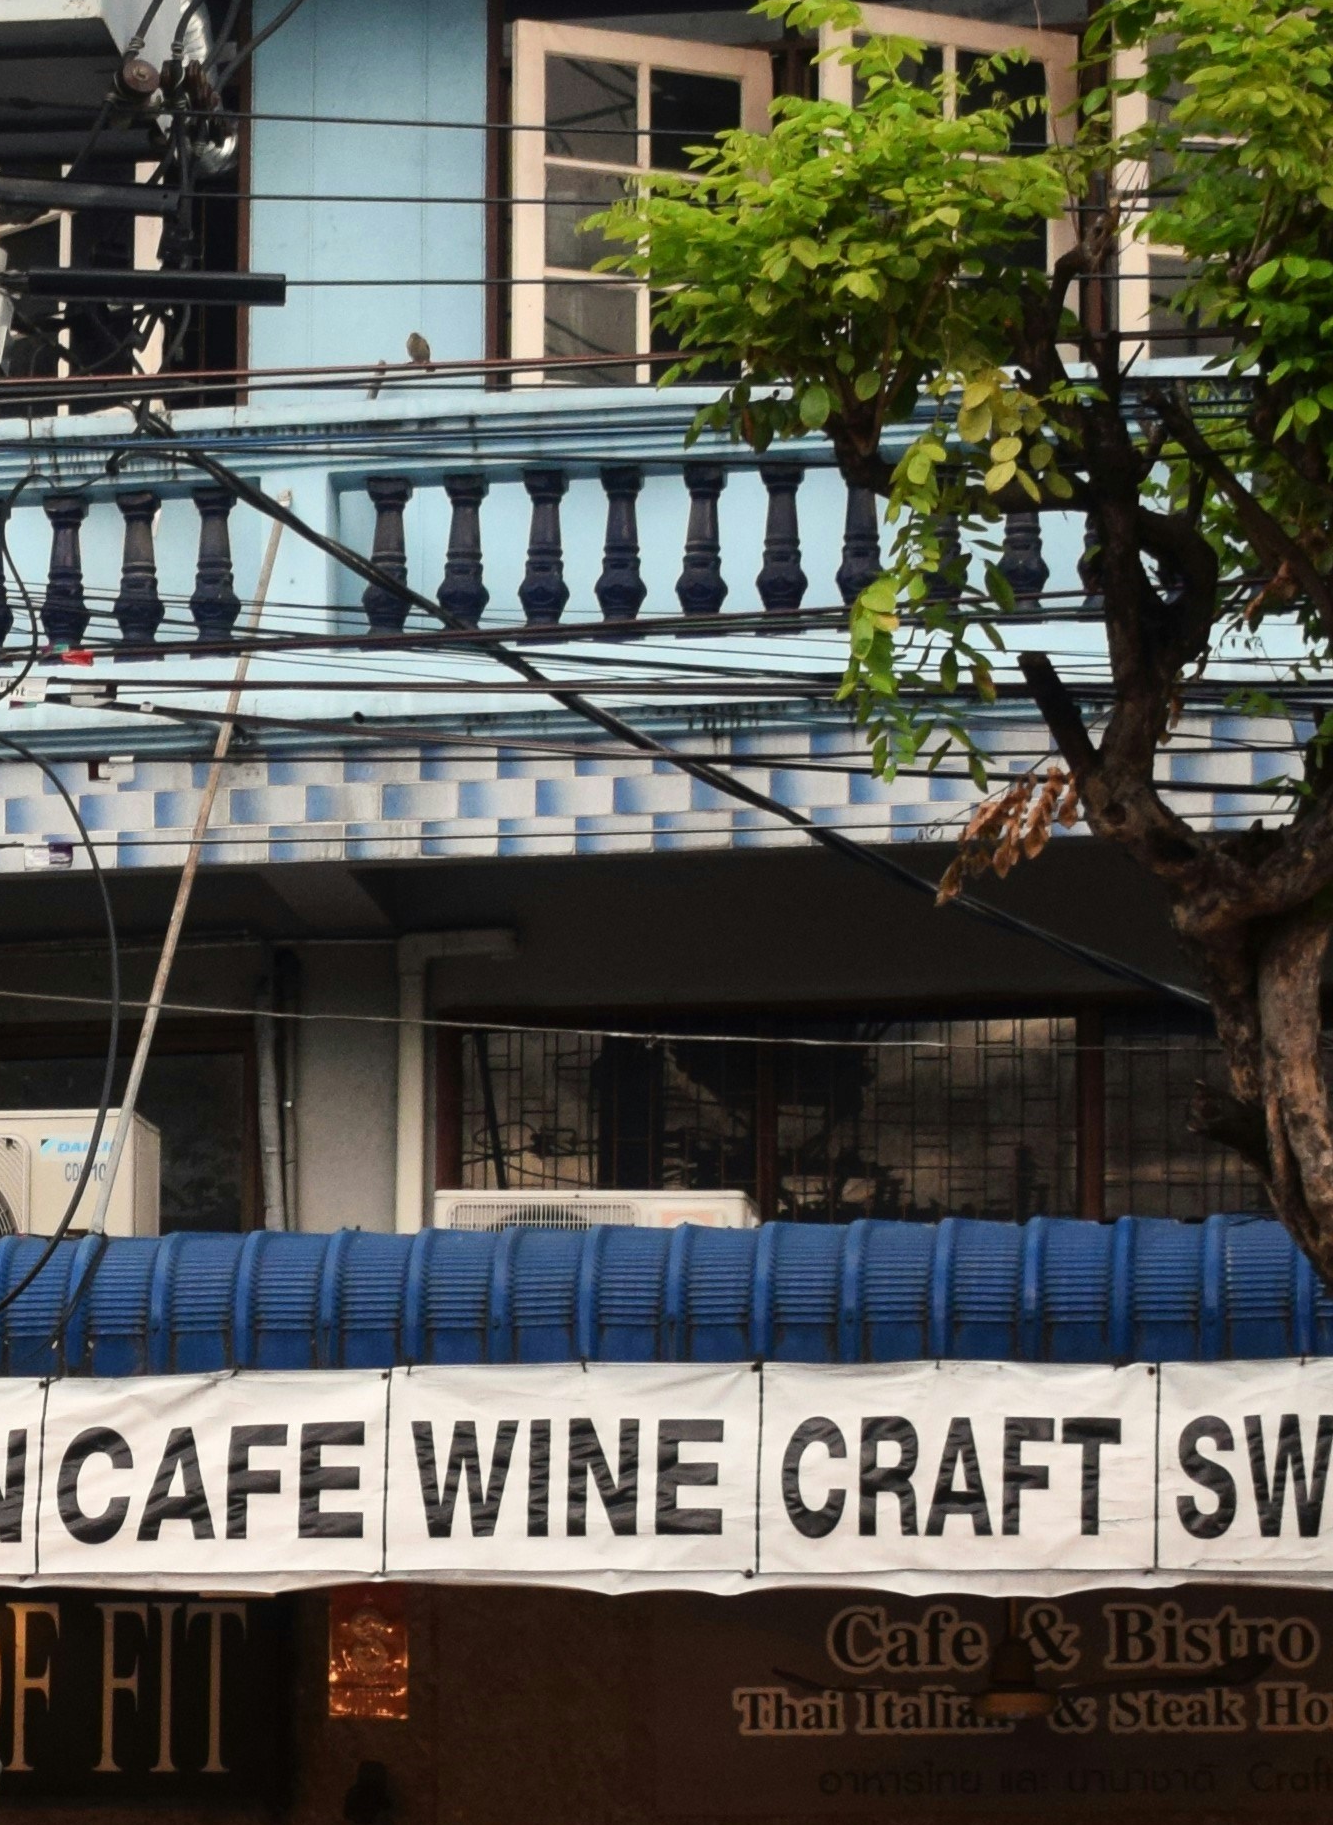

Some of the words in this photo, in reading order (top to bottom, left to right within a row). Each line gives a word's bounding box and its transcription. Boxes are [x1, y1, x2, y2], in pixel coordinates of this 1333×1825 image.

[56, 1422, 365, 1545] CAFE
[411, 1418, 724, 1537] WINE
[781, 1415, 1122, 1540] CRAFT
[1176, 1413, 1333, 1539] SW
[94, 1601, 247, 1774] FIT
[827, 1604, 988, 1674] Cafe
[1103, 1603, 1320, 1672] Bistro
[733, 1687, 845, 1735] Thai
[1108, 1686, 1248, 1732] Steak
